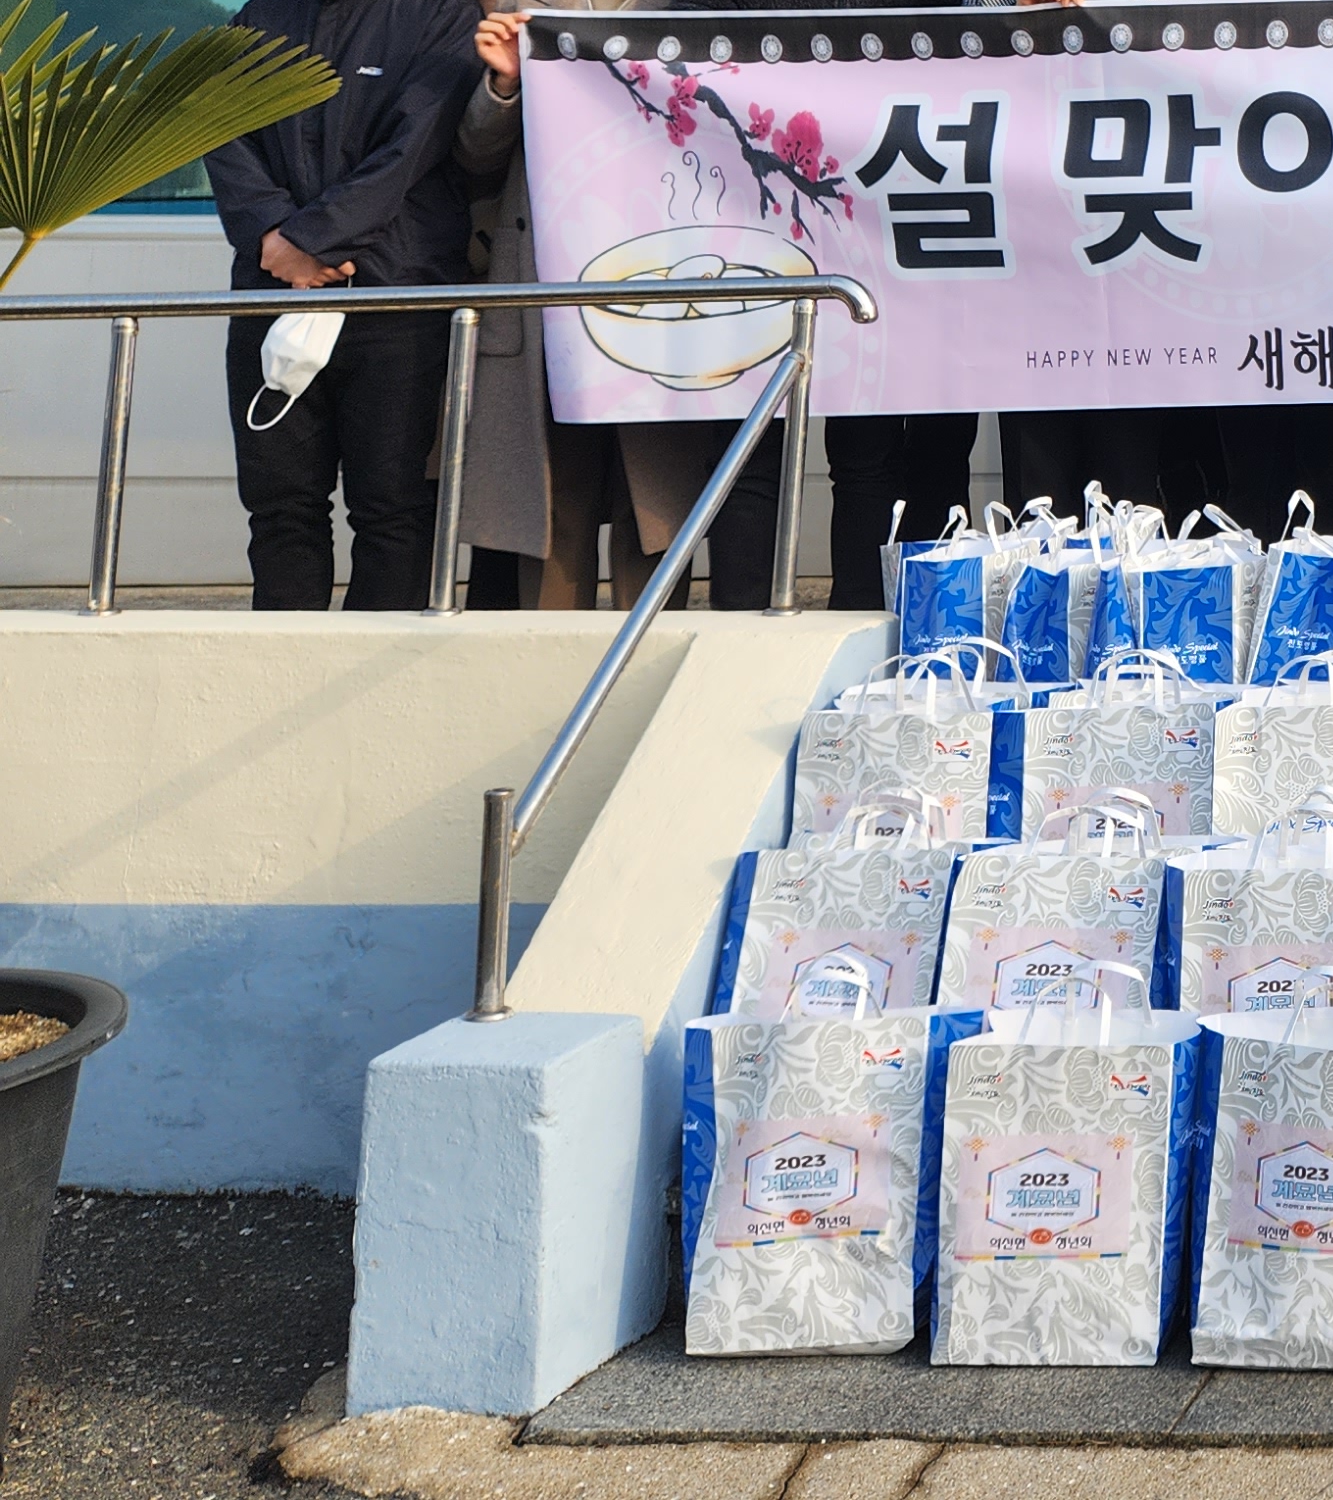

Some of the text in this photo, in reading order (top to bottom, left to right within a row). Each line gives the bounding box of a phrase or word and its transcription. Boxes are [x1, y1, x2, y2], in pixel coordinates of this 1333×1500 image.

[856, 100, 1006, 270] 설
[1026, 346, 1218, 368] HAPPY NEW YEAR
[1256, 979, 1304, 994] 202
[775, 1154, 826, 1170] 2023
[761, 1169, 838, 1193] 계묘년
[1020, 1173, 1069, 1187] 2023
[1283, 1165, 1329, 1181] 2023
[1006, 1189, 1081, 1208] 계묘년
